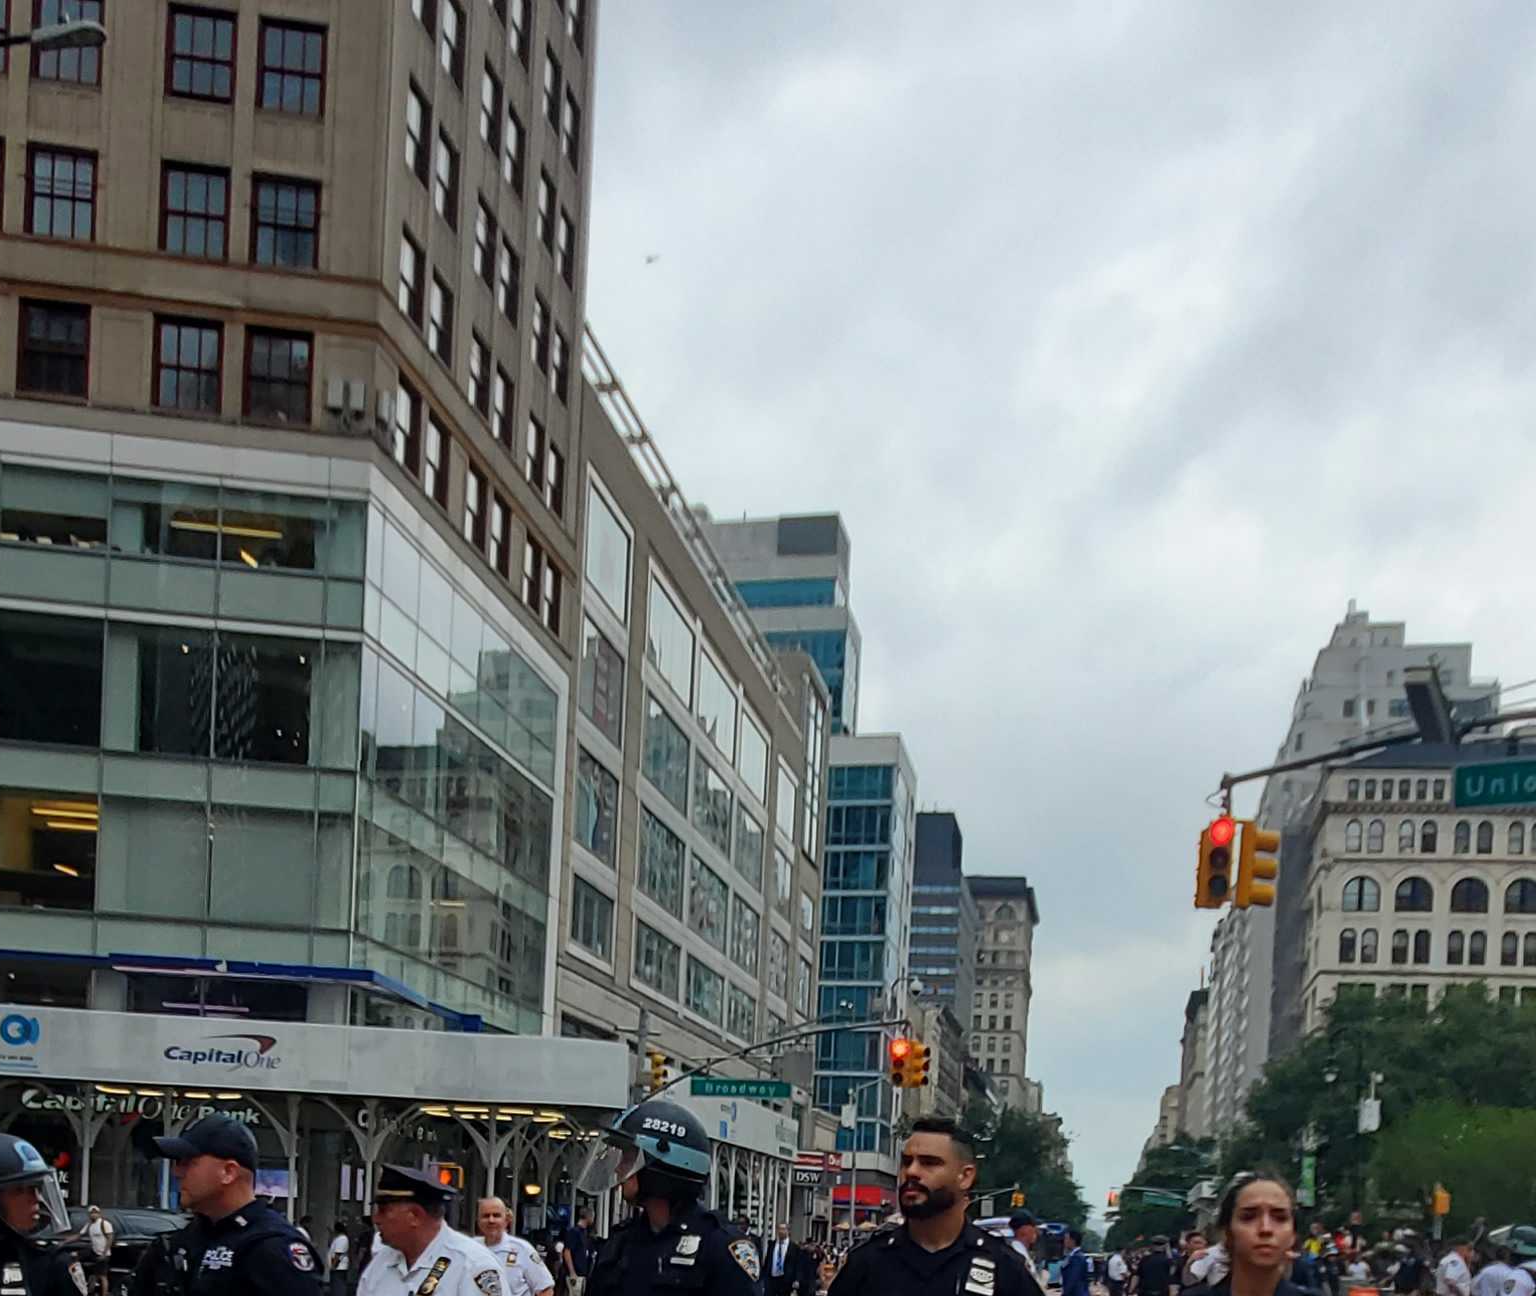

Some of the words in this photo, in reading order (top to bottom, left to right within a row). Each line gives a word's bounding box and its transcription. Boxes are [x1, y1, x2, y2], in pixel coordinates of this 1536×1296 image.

[704, 1082, 777, 1097] Broadway
[642, 1117, 687, 1138] 28219
[796, 1171, 821, 1183] DSW
